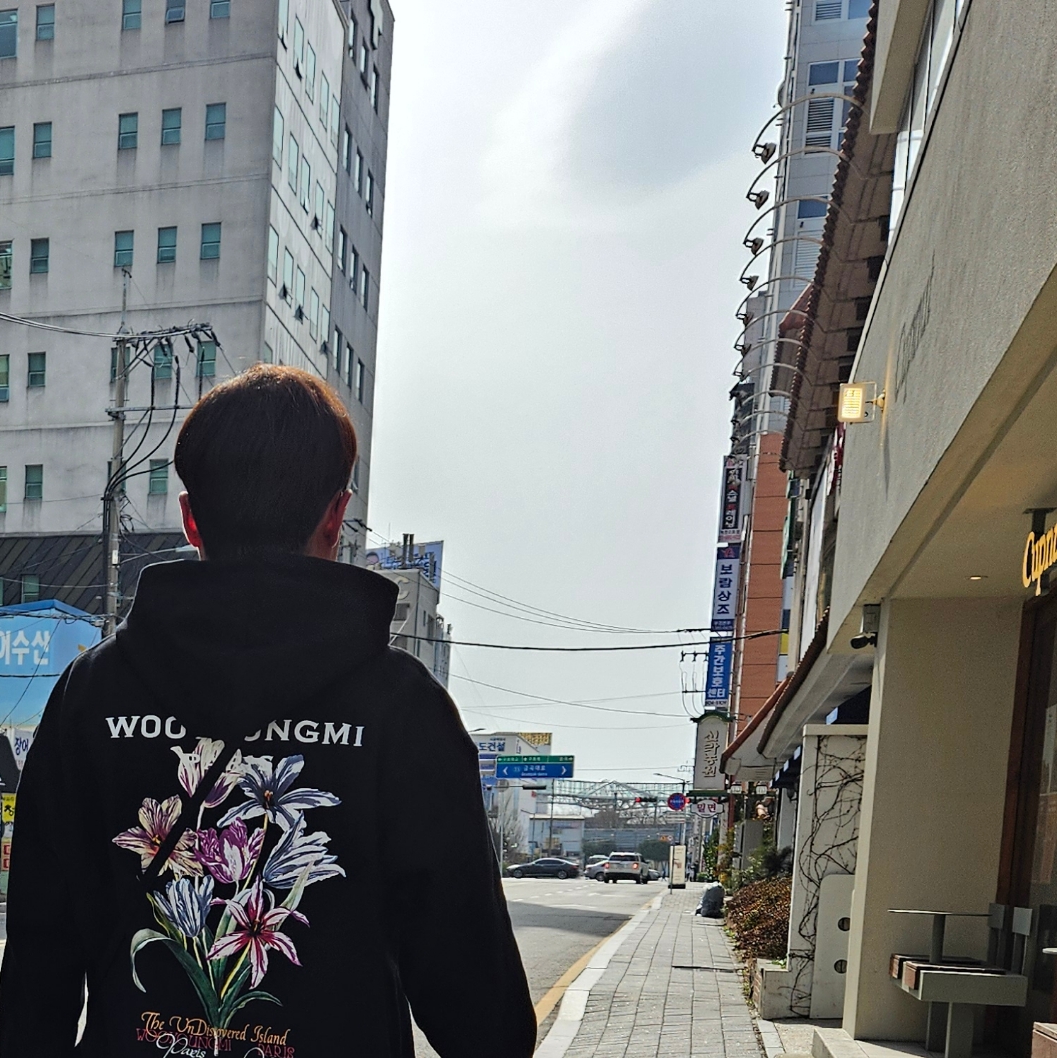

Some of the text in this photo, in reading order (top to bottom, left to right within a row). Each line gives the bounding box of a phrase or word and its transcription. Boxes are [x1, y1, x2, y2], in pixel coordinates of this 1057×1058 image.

[717, 564, 733, 615] 보람상조
[105, 714, 365, 747] WOONGMI
[697, 802, 716, 812] 밀면
[141, 1011, 291, 1046] The UnDisovered Island
